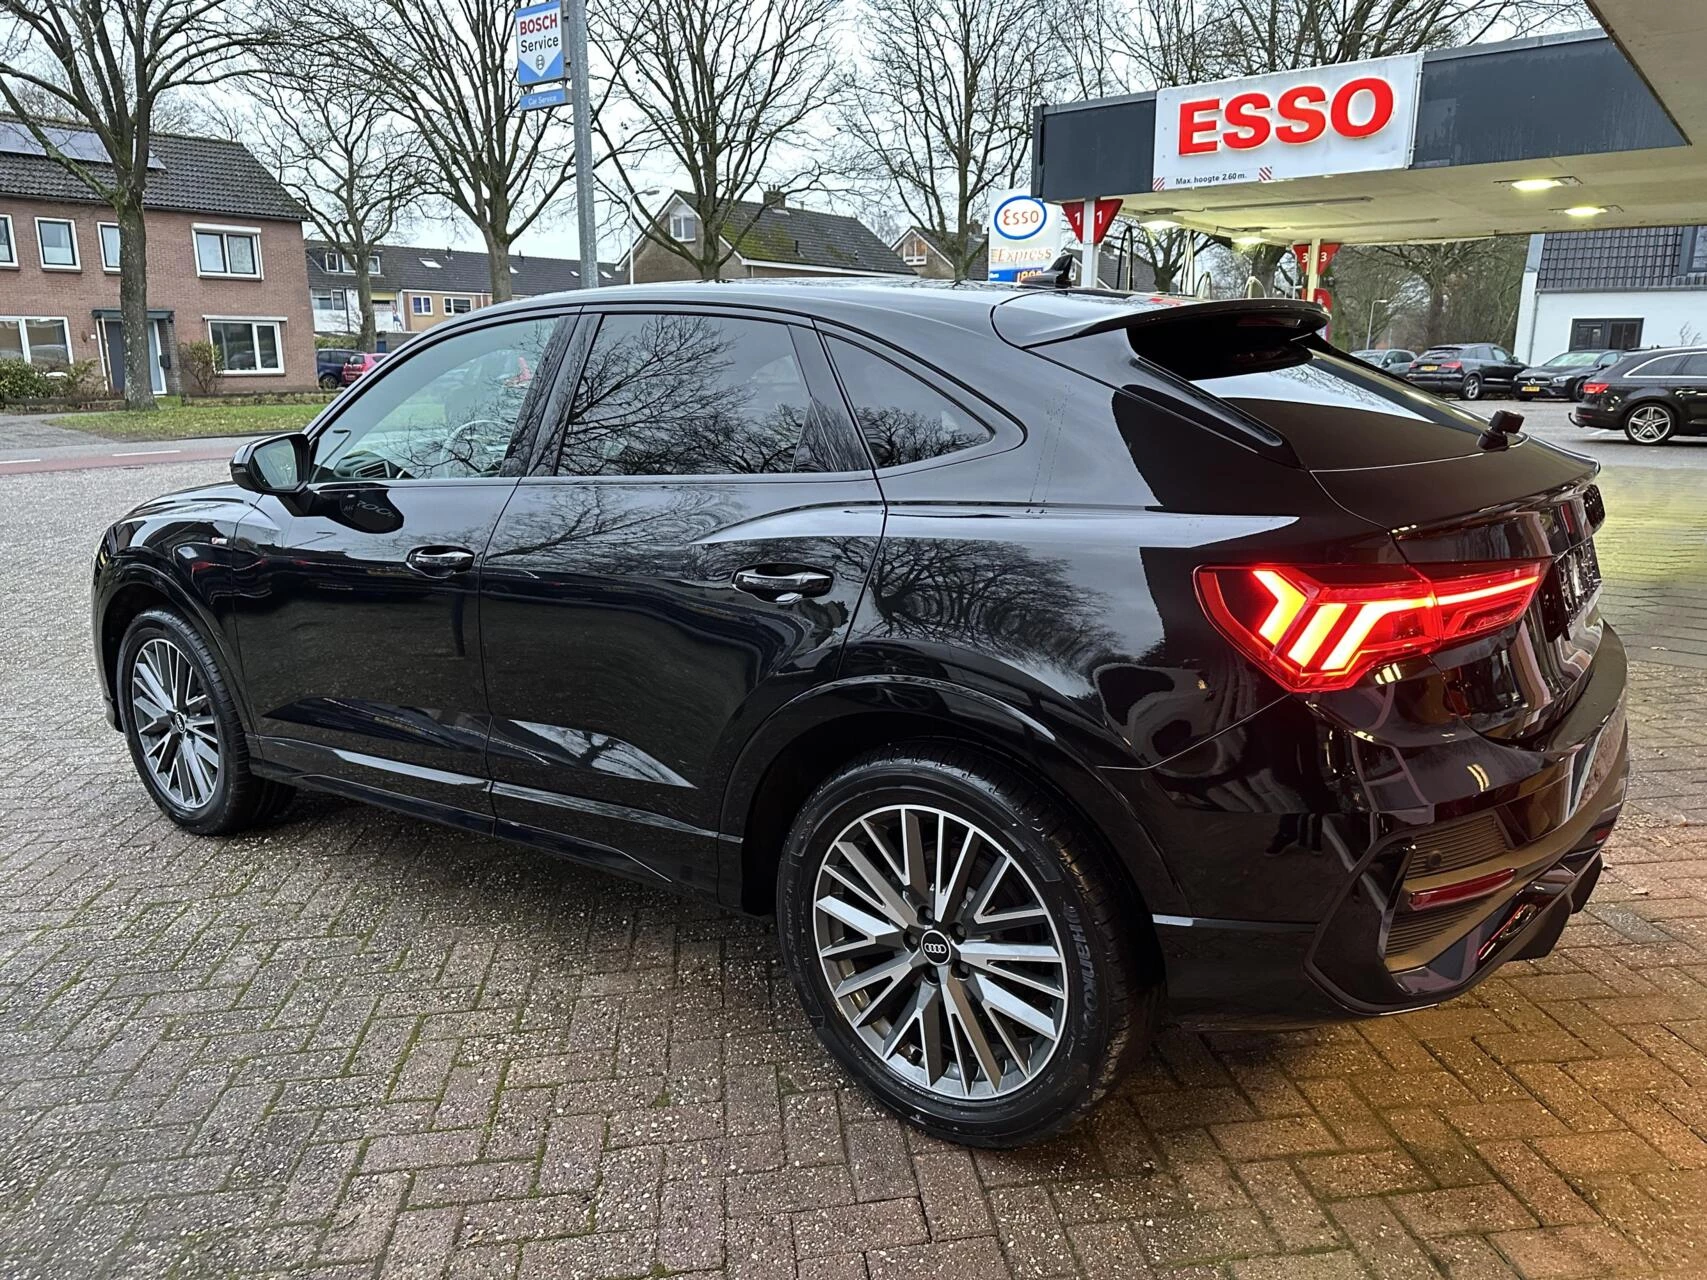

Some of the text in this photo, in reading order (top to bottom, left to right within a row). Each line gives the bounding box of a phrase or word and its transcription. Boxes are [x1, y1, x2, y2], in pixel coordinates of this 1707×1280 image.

[520, 13, 558, 36] BOSCH
[520, 35, 559, 54] Service
[1178, 77, 1394, 156] ESSO
[1194, 175, 1220, 184] hoogte
[1074, 211, 1081, 226] 1
[1096, 210, 1103, 225] 1
[997, 248, 1053, 263] Express
[1302, 252, 1309, 263] 3
[1320, 251, 1328, 262] 3
